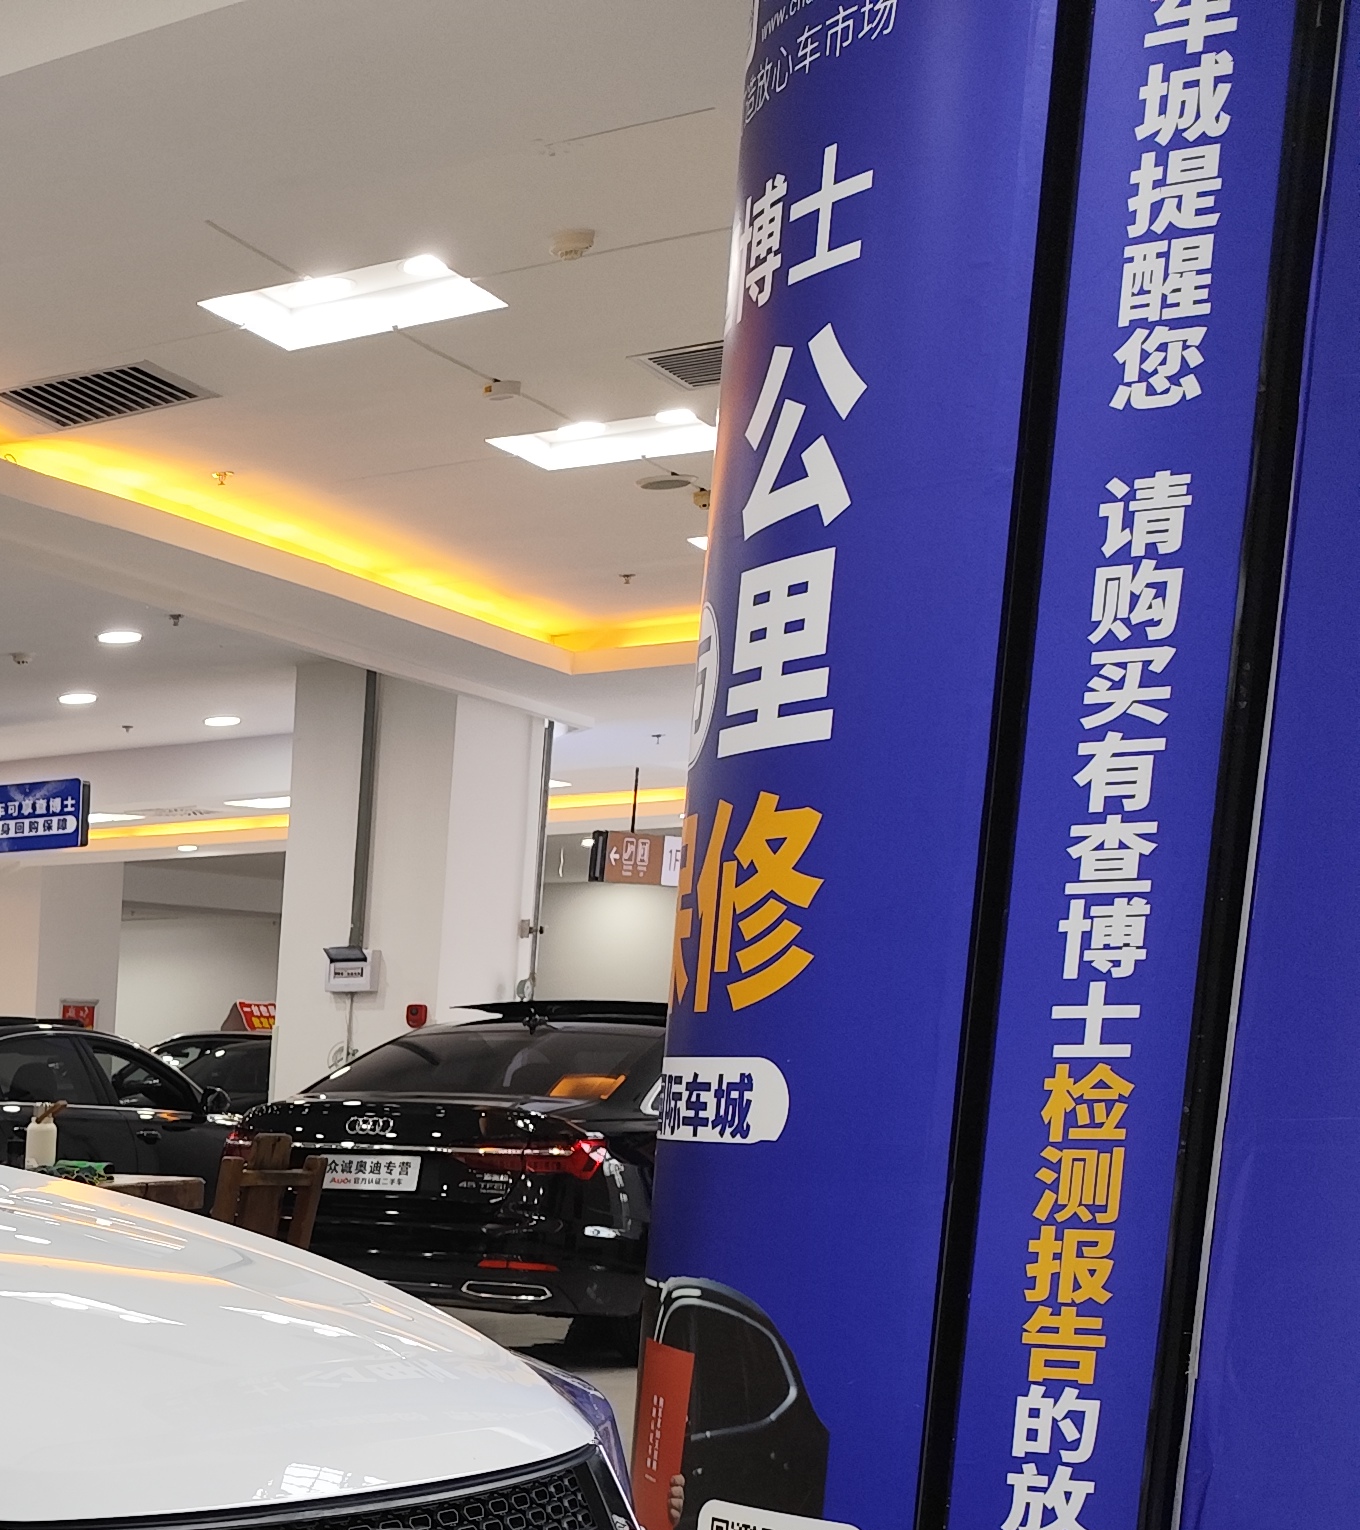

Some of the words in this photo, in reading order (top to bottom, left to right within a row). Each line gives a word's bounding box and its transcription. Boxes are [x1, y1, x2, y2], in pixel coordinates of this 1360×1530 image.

[728, 142, 875, 328] 博士
[326, 1159, 412, 1176] 众诚奥迪专营
